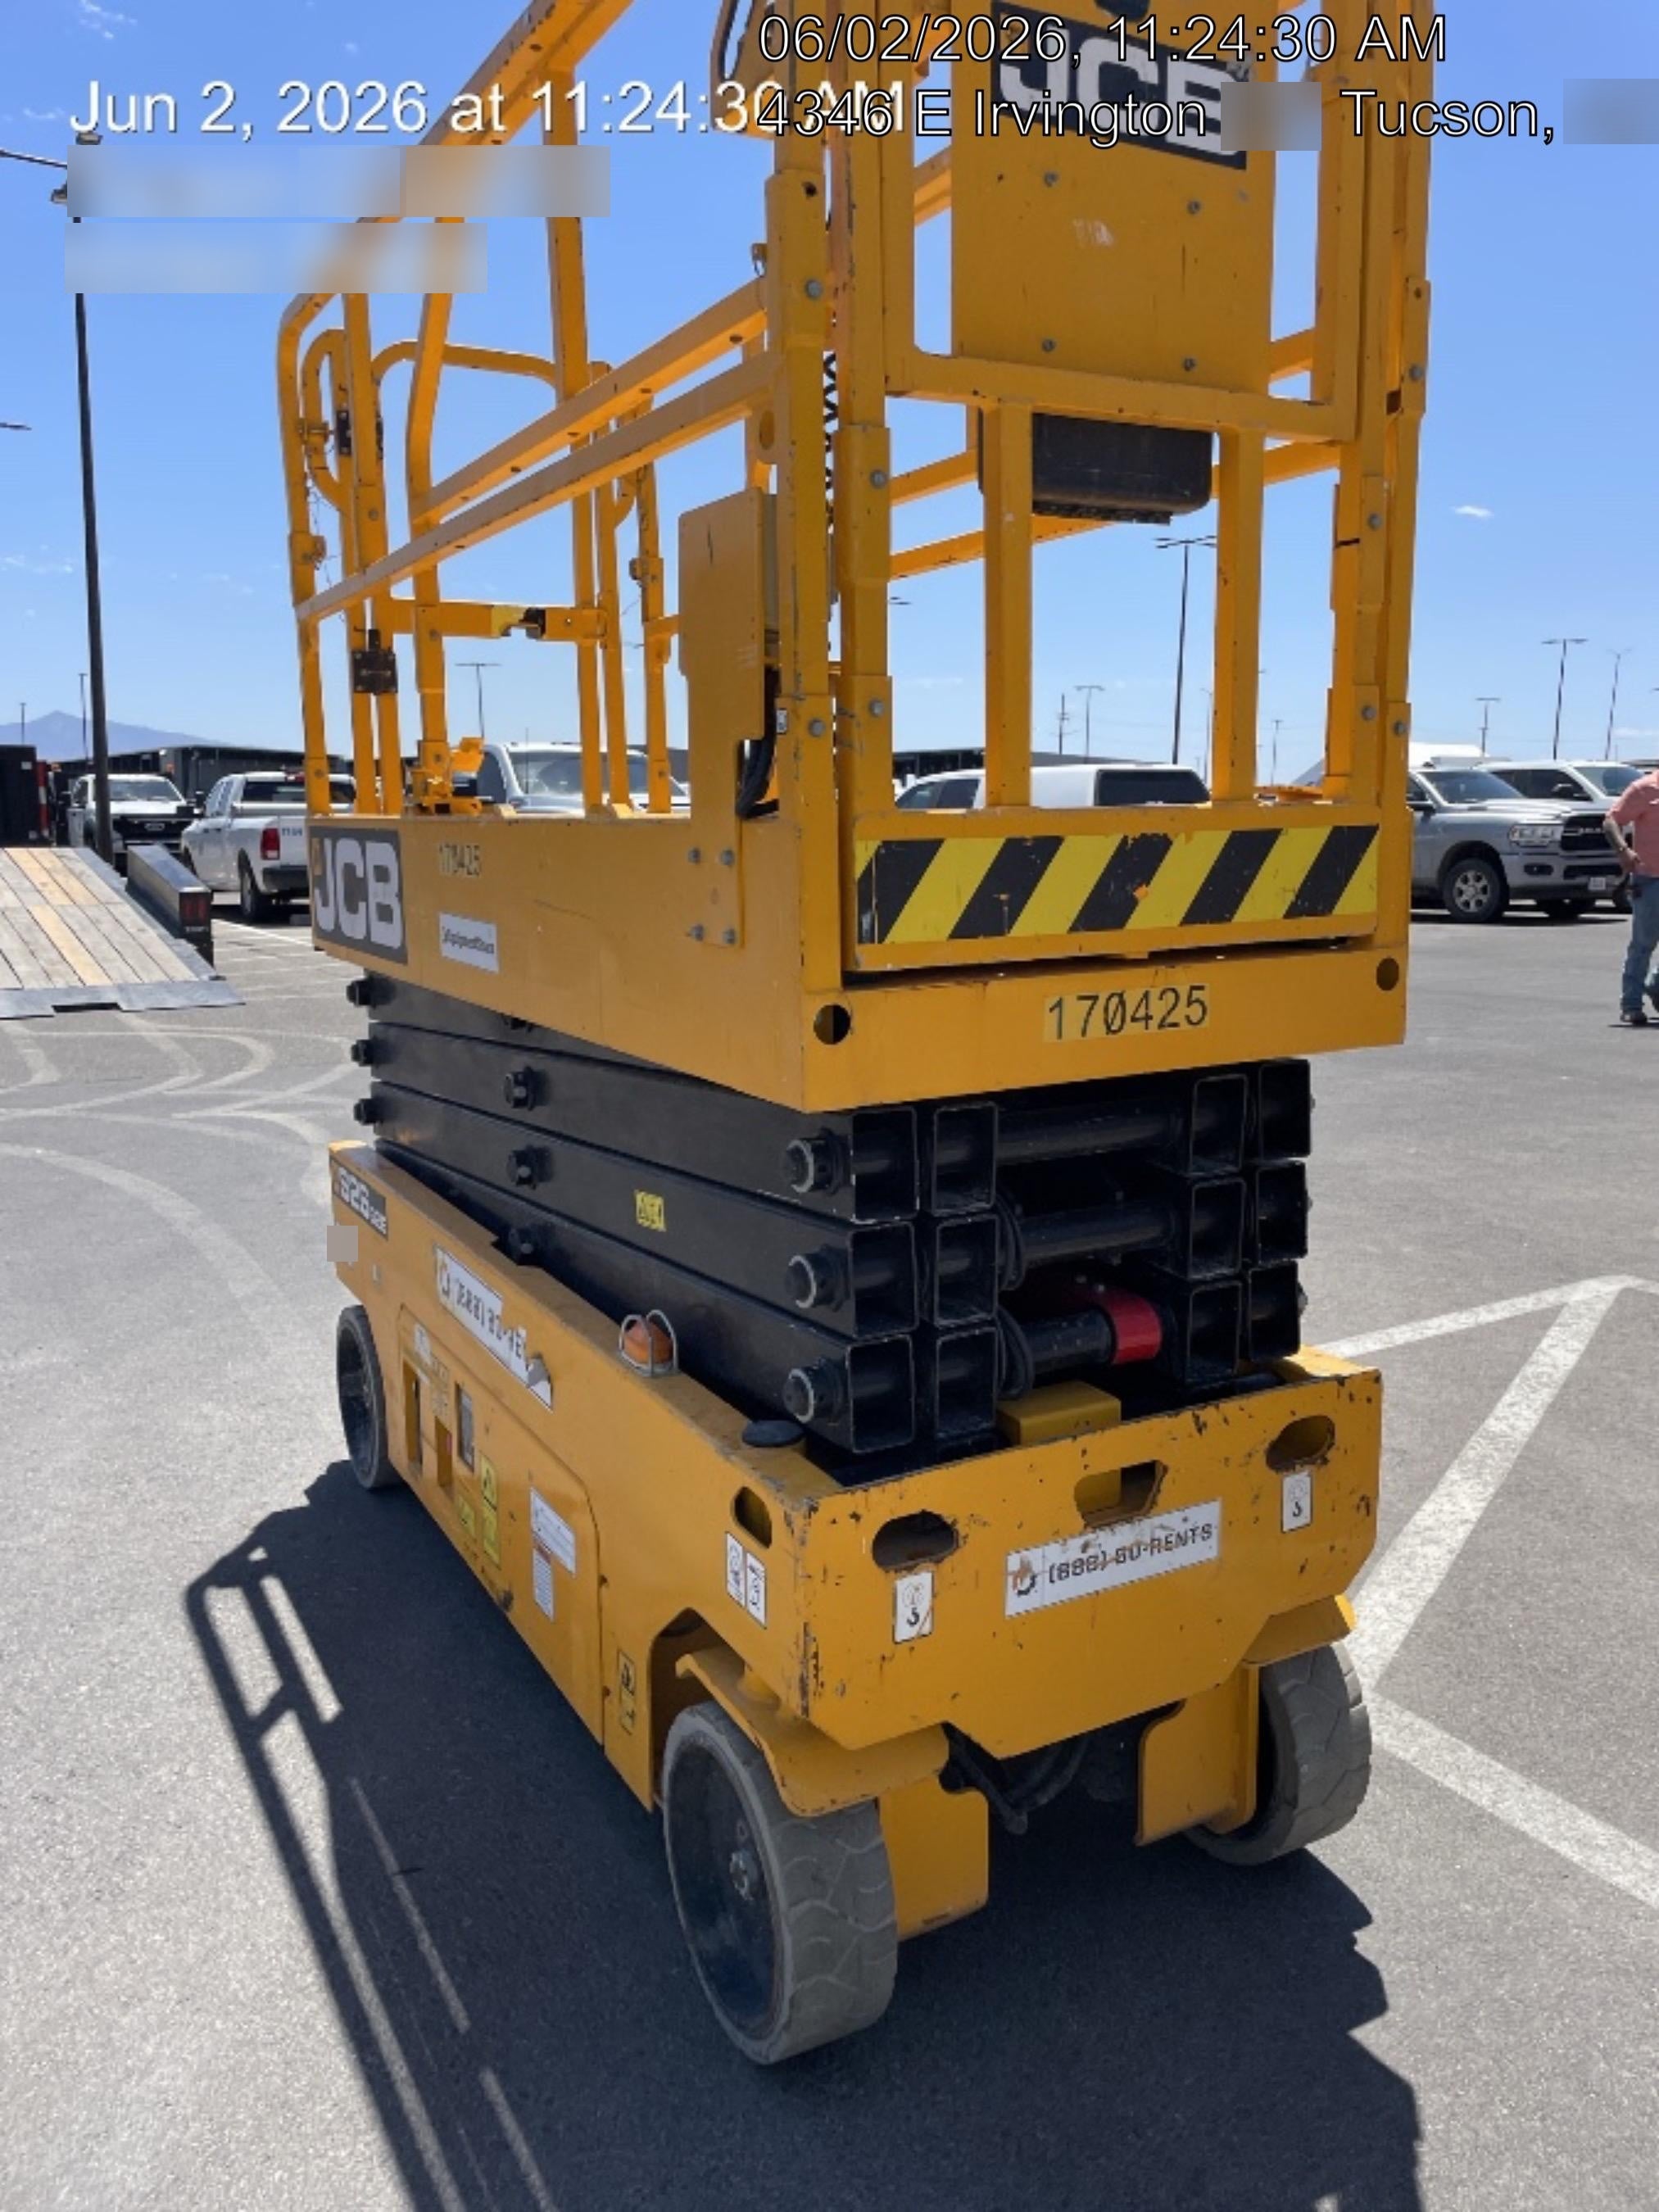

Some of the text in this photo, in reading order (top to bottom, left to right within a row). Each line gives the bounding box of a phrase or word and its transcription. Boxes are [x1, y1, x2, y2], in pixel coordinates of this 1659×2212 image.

[1000, 25, 1240, 156] JCB
[314, 837, 403, 950] JCB
[1049, 985, 1208, 1040] 170425
